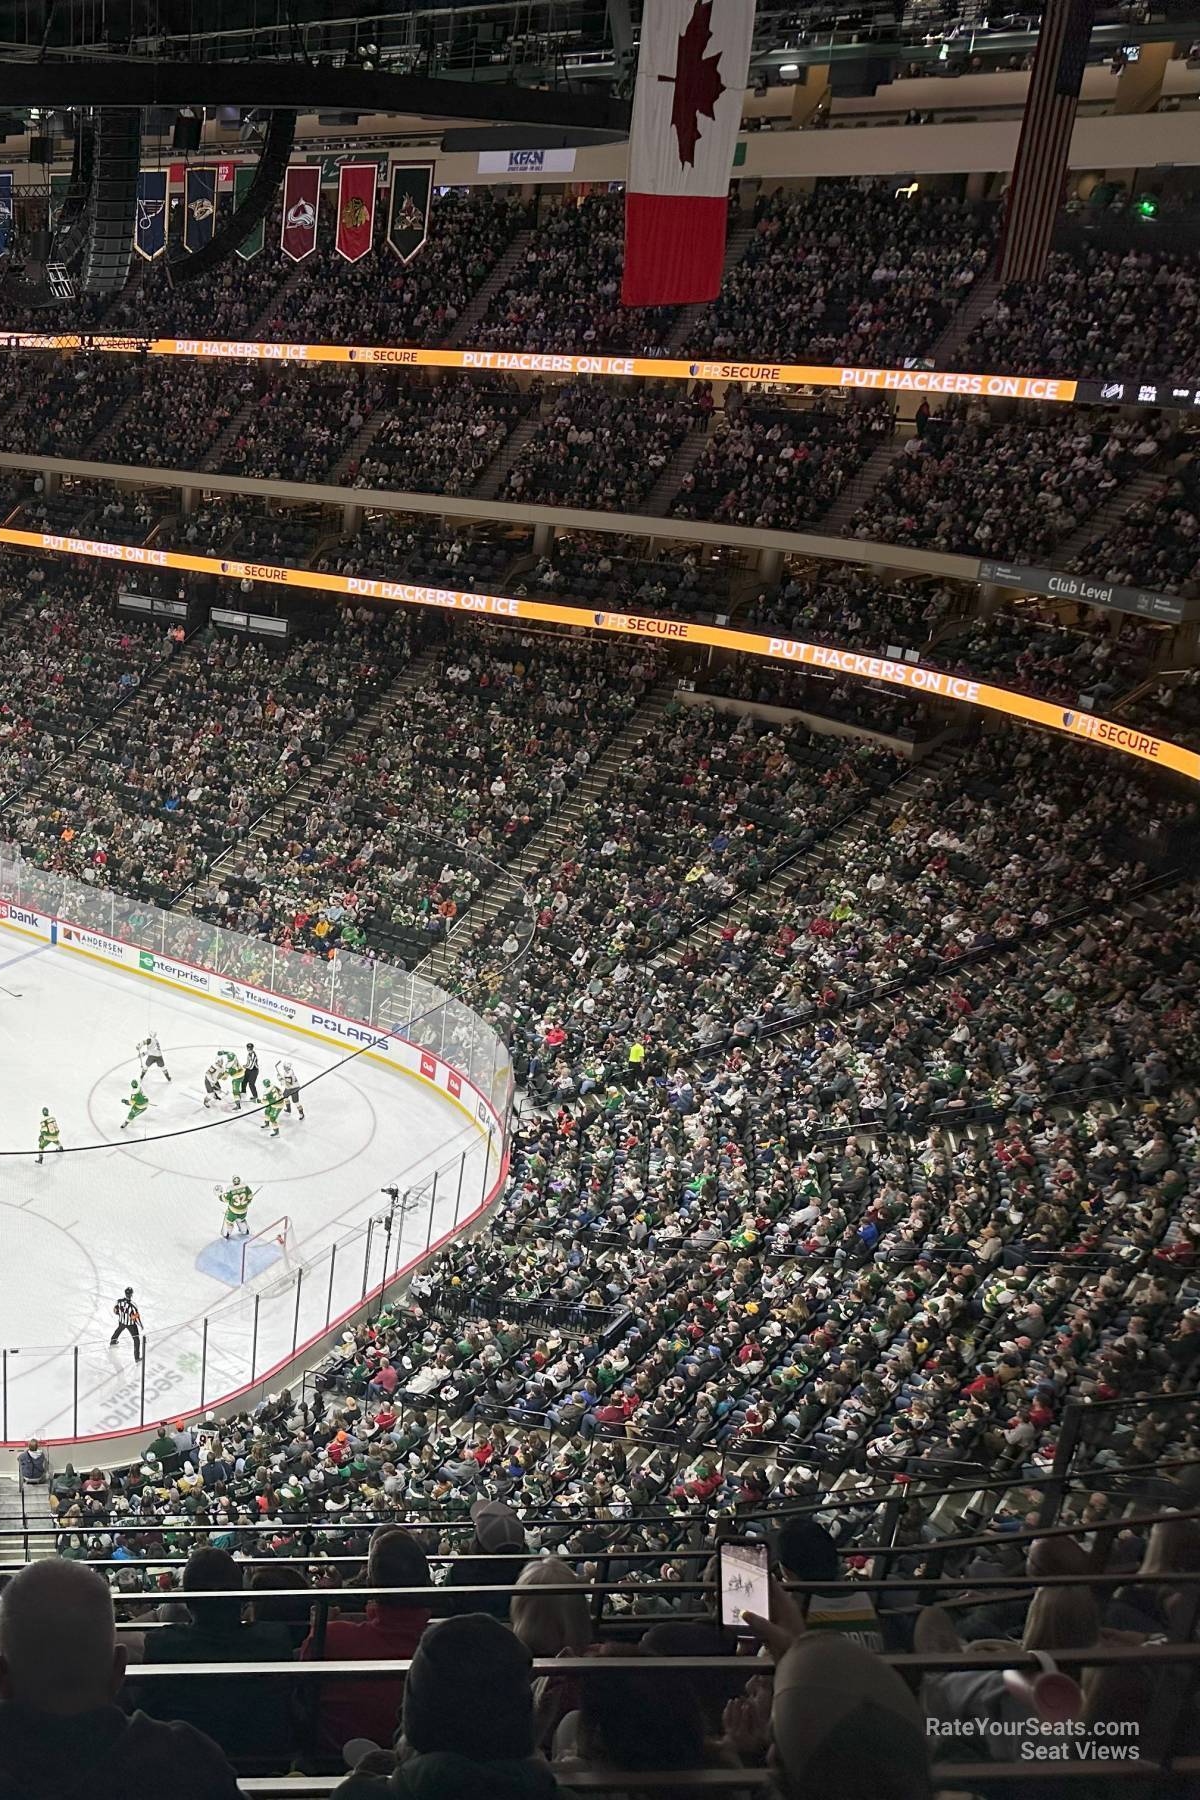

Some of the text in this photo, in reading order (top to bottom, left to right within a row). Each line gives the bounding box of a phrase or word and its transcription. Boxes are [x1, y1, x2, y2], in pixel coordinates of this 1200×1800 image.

[175, 341, 307, 359] PUT HACKERS ON ICE
[358, 350, 418, 363] FRSECURE
[463, 353, 634, 375] PUT HACKERS ON ICE
[702, 364, 781, 381] FRSECURE
[840, 370, 1059, 400] PUT HACKERS ON ICE
[43, 535, 167, 565] PUT HACKERS ON ICE
[229, 562, 288, 581] FRSECURE
[347, 578, 519, 615] PUT HACKERS ON ICE
[1048, 577, 1113, 603] Club Level
[608, 614, 688, 638] FRSECURE
[768, 638, 981, 702] PUT HACKERS ON ICE
[1077, 714, 1161, 757] FRSECURE
[10, 907, 38, 927] bank
[81, 934, 123, 954] ANDERSEN
[141, 955, 208, 985] enterprise
[311, 1014, 389, 1051] POLARIS
[232, 1192, 247, 1207] 32
